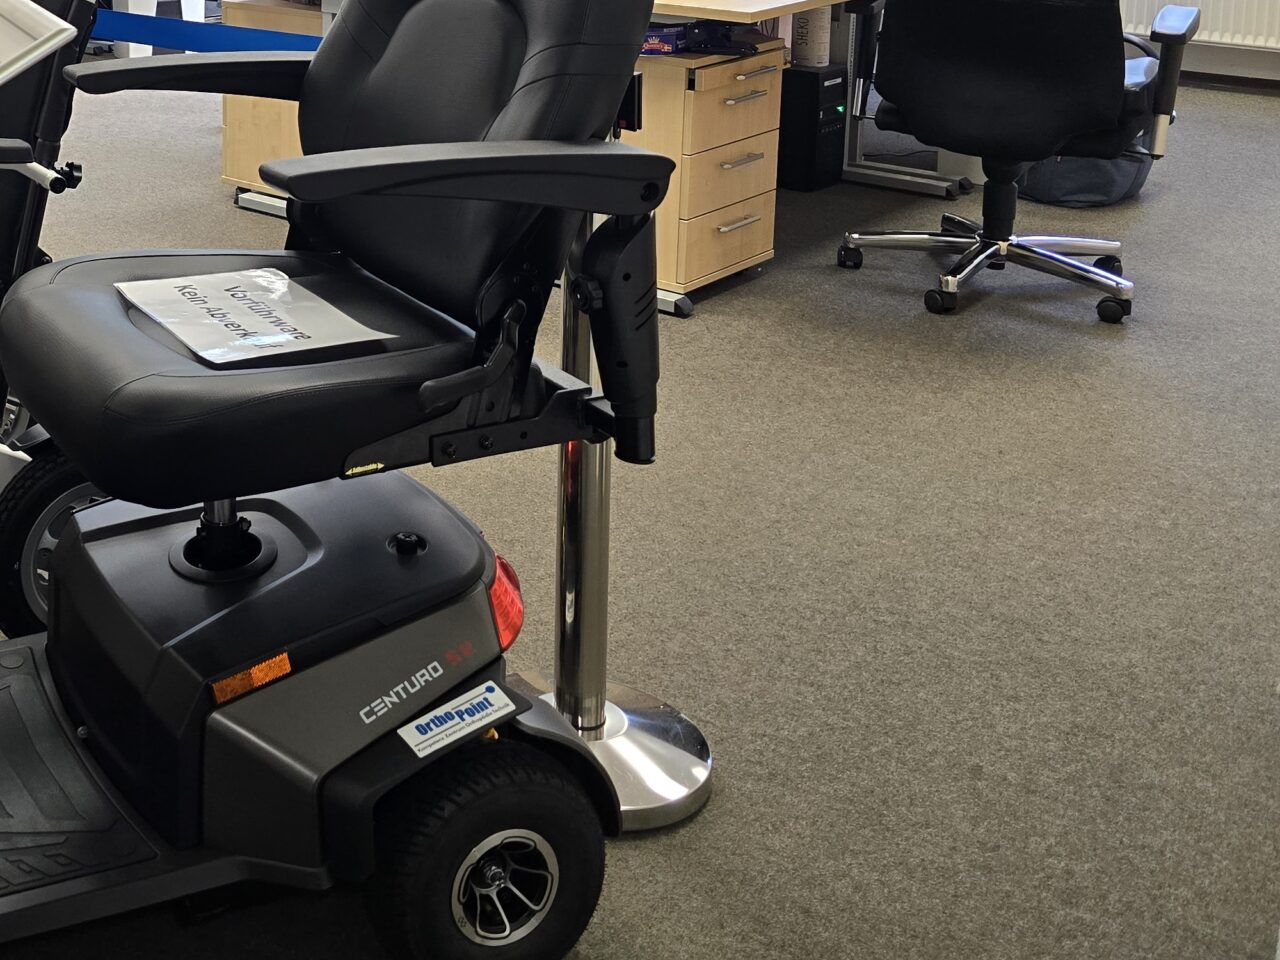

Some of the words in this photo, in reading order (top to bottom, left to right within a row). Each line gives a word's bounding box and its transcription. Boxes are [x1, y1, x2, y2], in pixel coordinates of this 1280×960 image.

[796, 17, 809, 46] SHEKO
[174, 284, 209, 308] Kein
[223, 285, 312, 341] Vorführware
[358, 660, 444, 725] CENTURO
[414, 710, 456, 737] Ortho
[454, 696, 495, 723] Point
